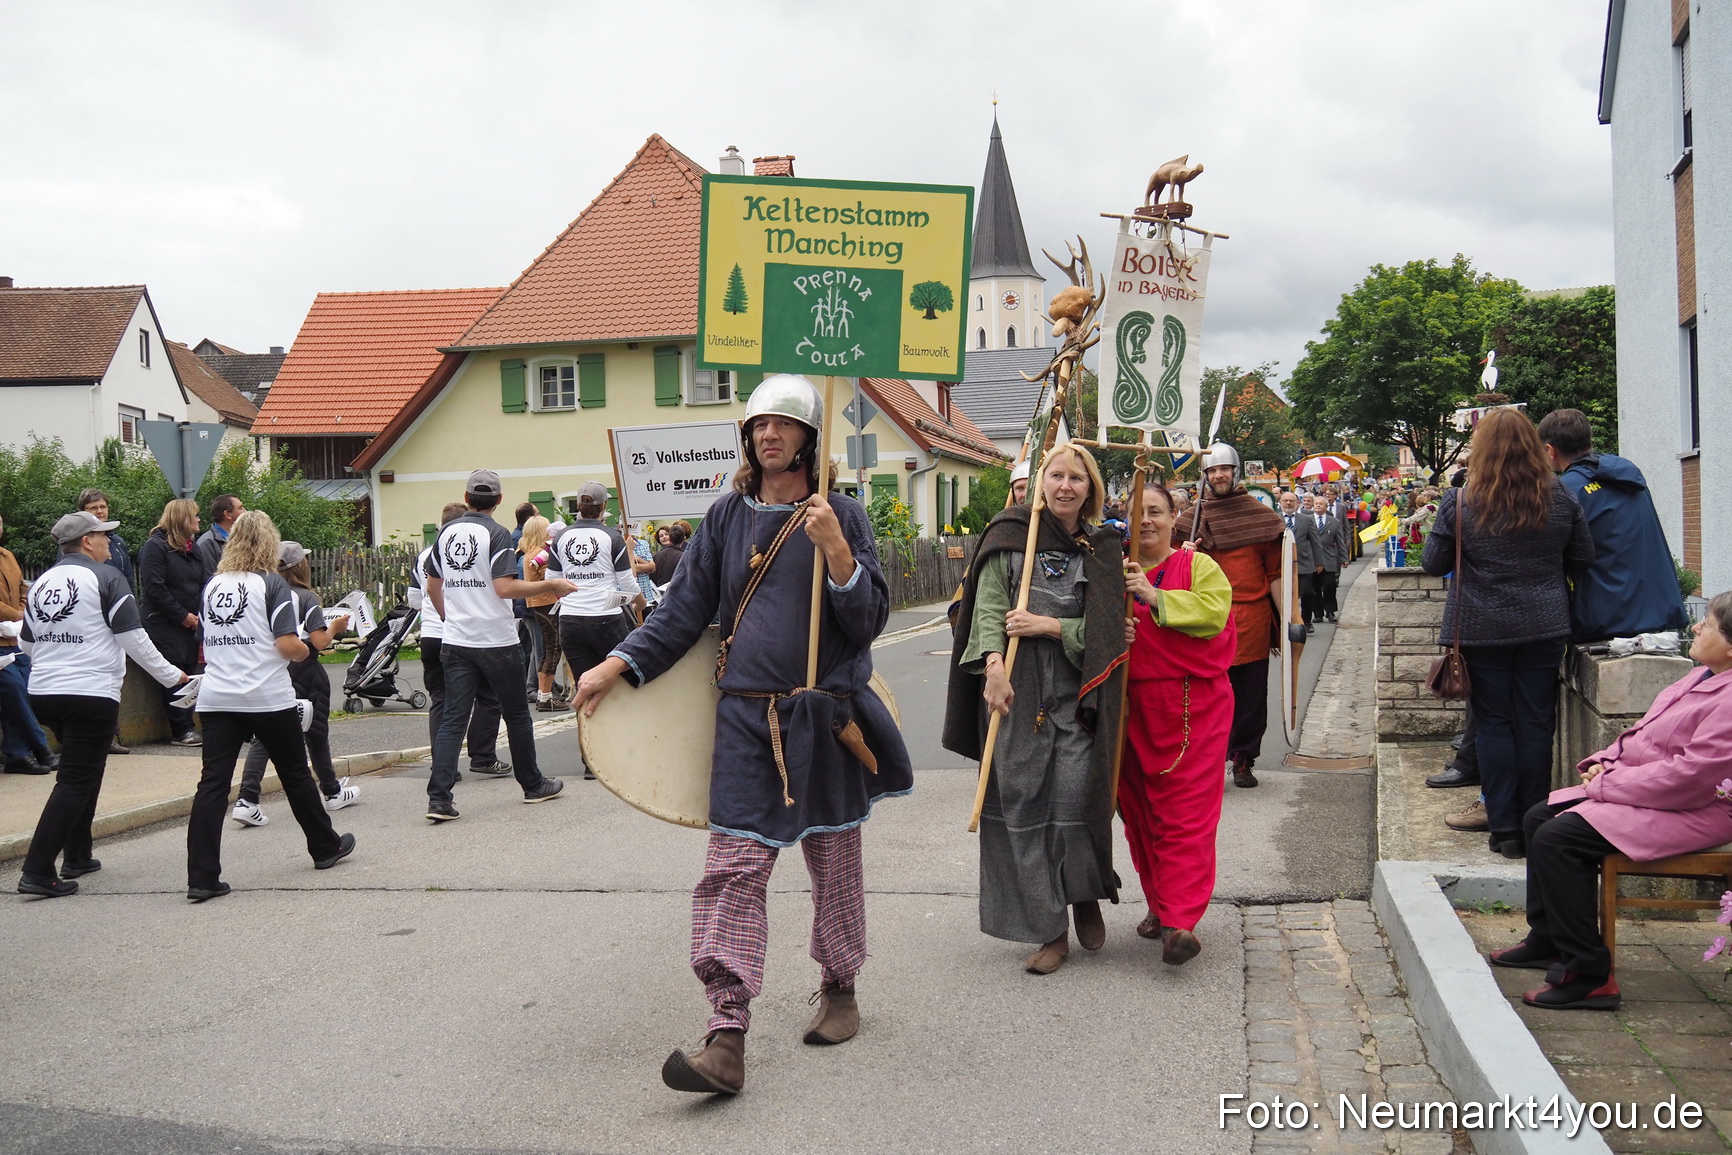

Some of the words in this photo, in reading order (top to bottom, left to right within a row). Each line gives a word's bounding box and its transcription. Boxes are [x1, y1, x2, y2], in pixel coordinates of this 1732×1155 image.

[743, 195, 930, 228] Keltenstamm
[764, 228, 904, 264] Manching
[707, 334, 759, 348] Vindeliker-
[903, 344, 951, 358] Baumvolk
[632, 452, 649, 465] 25.
[655, 448, 736, 464] Volksfestbus
[646, 479, 667, 492] der
[673, 477, 711, 491] swn
[575, 544, 590, 555] 25.
[43, 589, 63, 606] 25.
[216, 592, 235, 608] 25.
